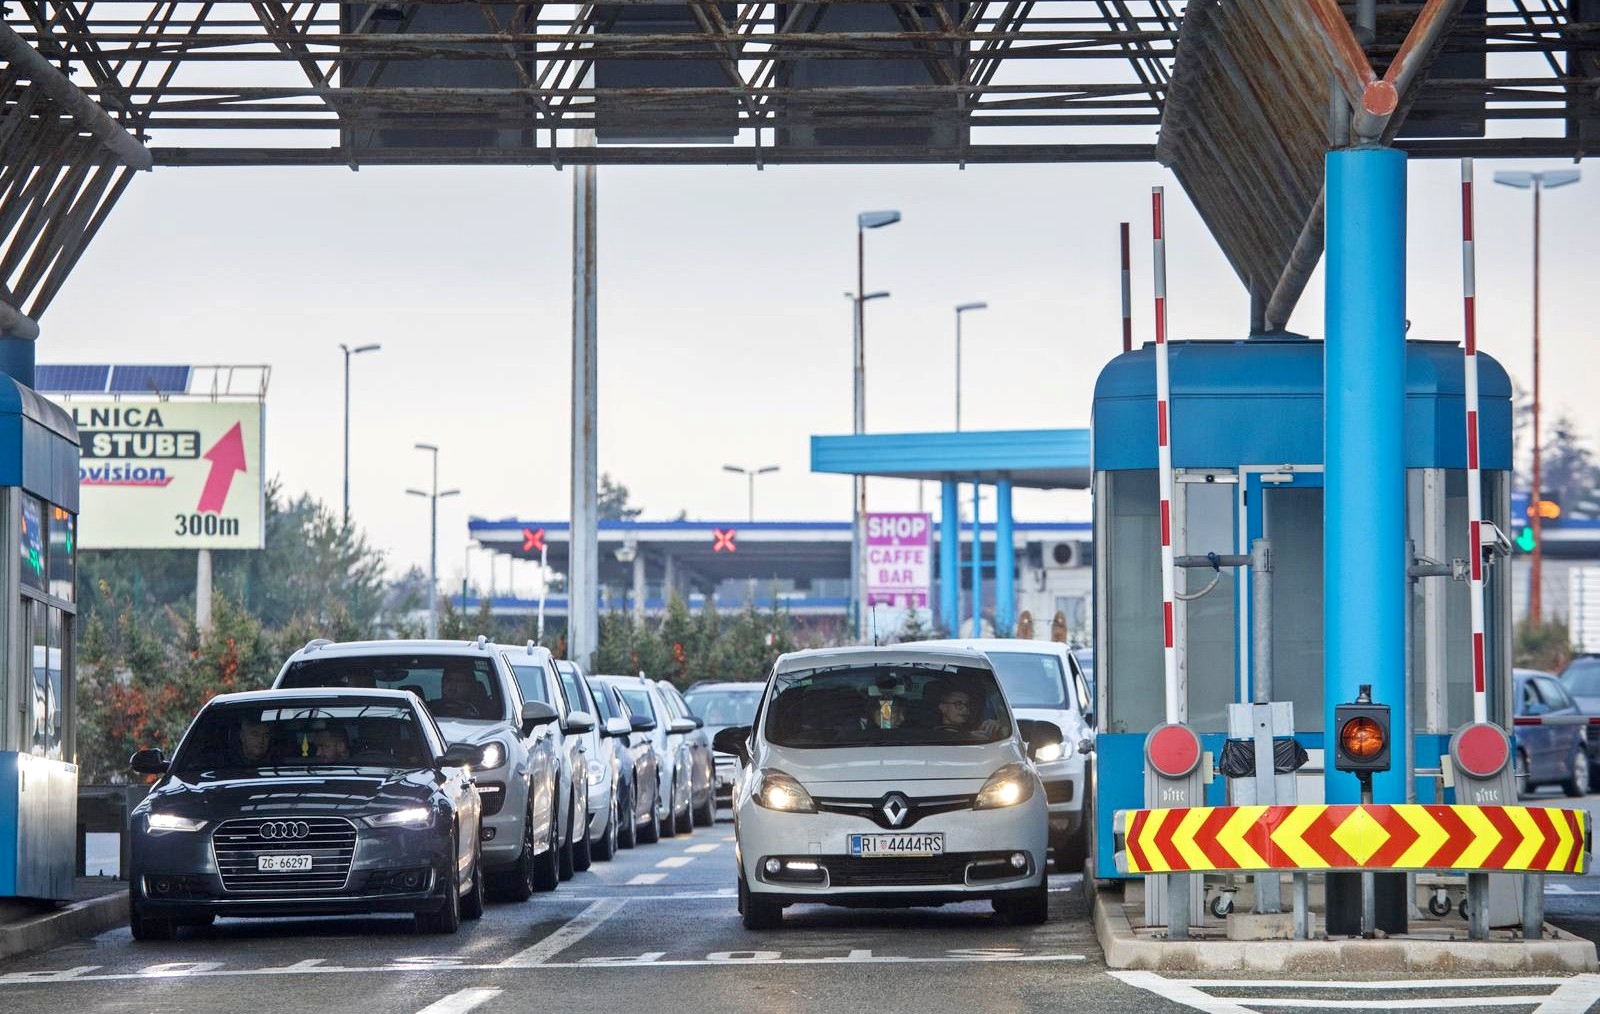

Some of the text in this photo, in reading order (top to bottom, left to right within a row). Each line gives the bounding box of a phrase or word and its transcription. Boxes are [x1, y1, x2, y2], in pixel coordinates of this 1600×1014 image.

[92, 432, 196, 458] STUBE
[175, 513, 239, 536] 300m
[868, 516, 926, 539] SHOP
[870, 549, 925, 565] CAFFE
[879, 568, 913, 583] BAR
[862, 837, 877, 852] RI
